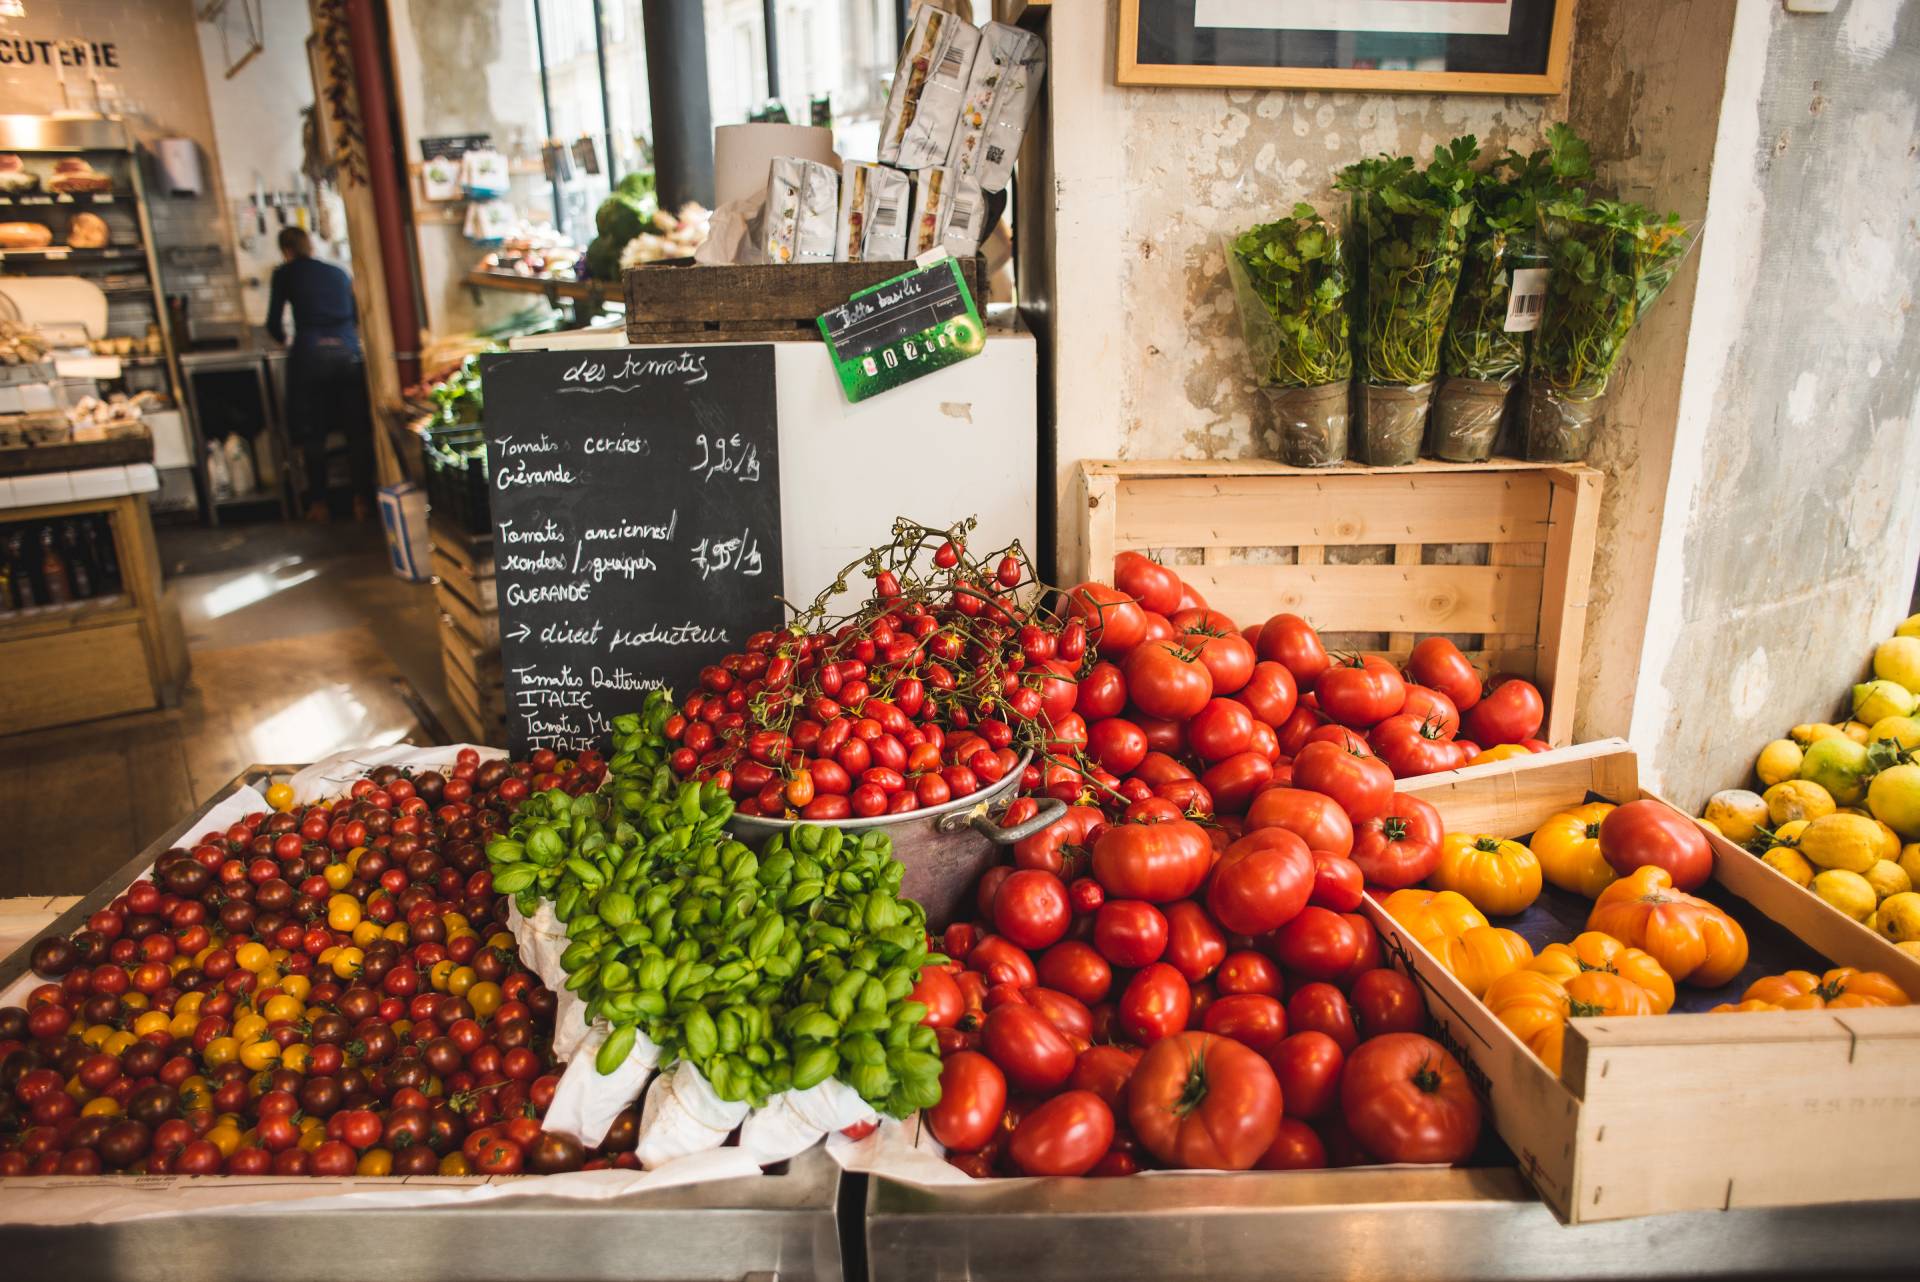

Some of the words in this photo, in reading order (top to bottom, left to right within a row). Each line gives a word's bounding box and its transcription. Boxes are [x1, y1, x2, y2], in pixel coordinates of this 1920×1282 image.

[563, 359, 606, 382] des
[613, 351, 708, 385] tomates
[495, 433, 558, 458] Tomates
[584, 432, 643, 454] cerises
[499, 518, 564, 544] Tomates
[507, 583, 591, 606] GUERANDE
[541, 620, 603, 645] direct
[609, 621, 730, 653] producteur
[512, 664, 583, 687] Tomates
[516, 690, 593, 709] ITALIE
[521, 711, 581, 734] Tomates
[588, 712, 612, 734] Me
